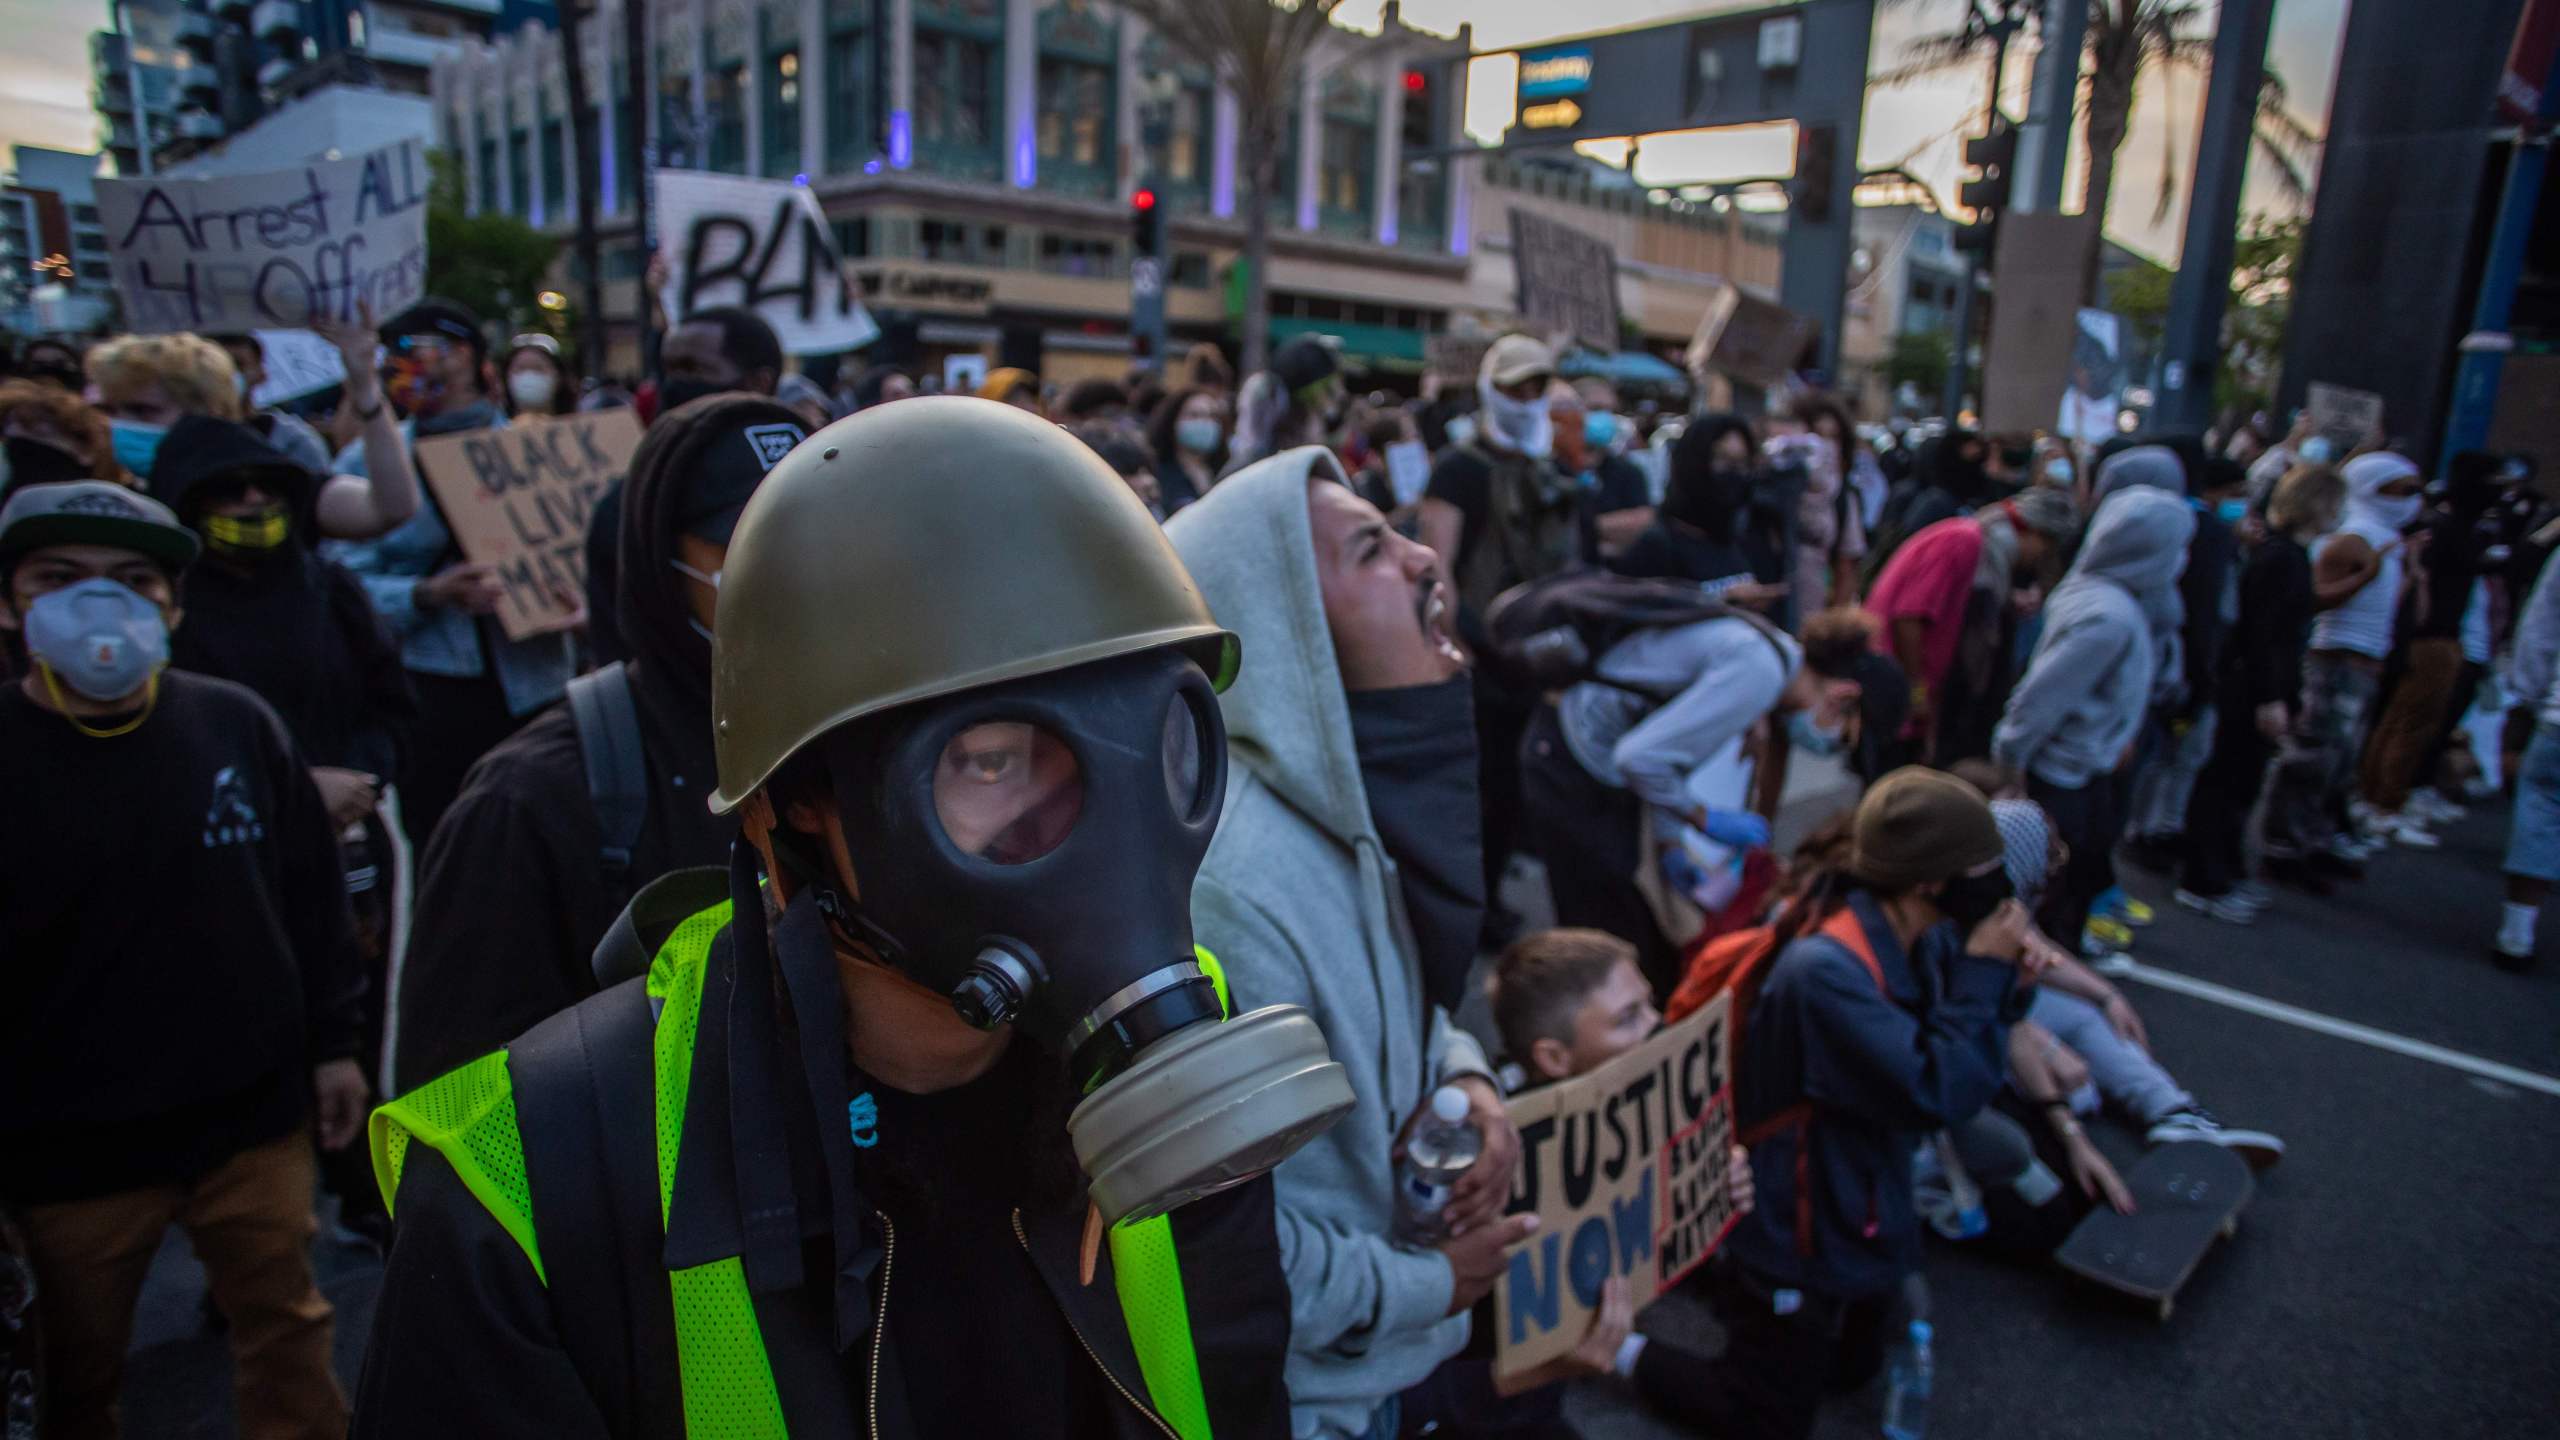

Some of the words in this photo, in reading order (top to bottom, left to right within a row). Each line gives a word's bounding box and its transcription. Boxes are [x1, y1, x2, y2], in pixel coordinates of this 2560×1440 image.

[119, 168, 331, 251] Arrest
[355, 139, 426, 226] ALL
[140, 259, 204, 326] 4
[682, 197, 850, 321] BLM
[464, 423, 611, 495] BLACK
[500, 545, 587, 619] MAT
[1507, 1022, 1722, 1216] JUSTICE
[1508, 1169, 1653, 1345] NOW
